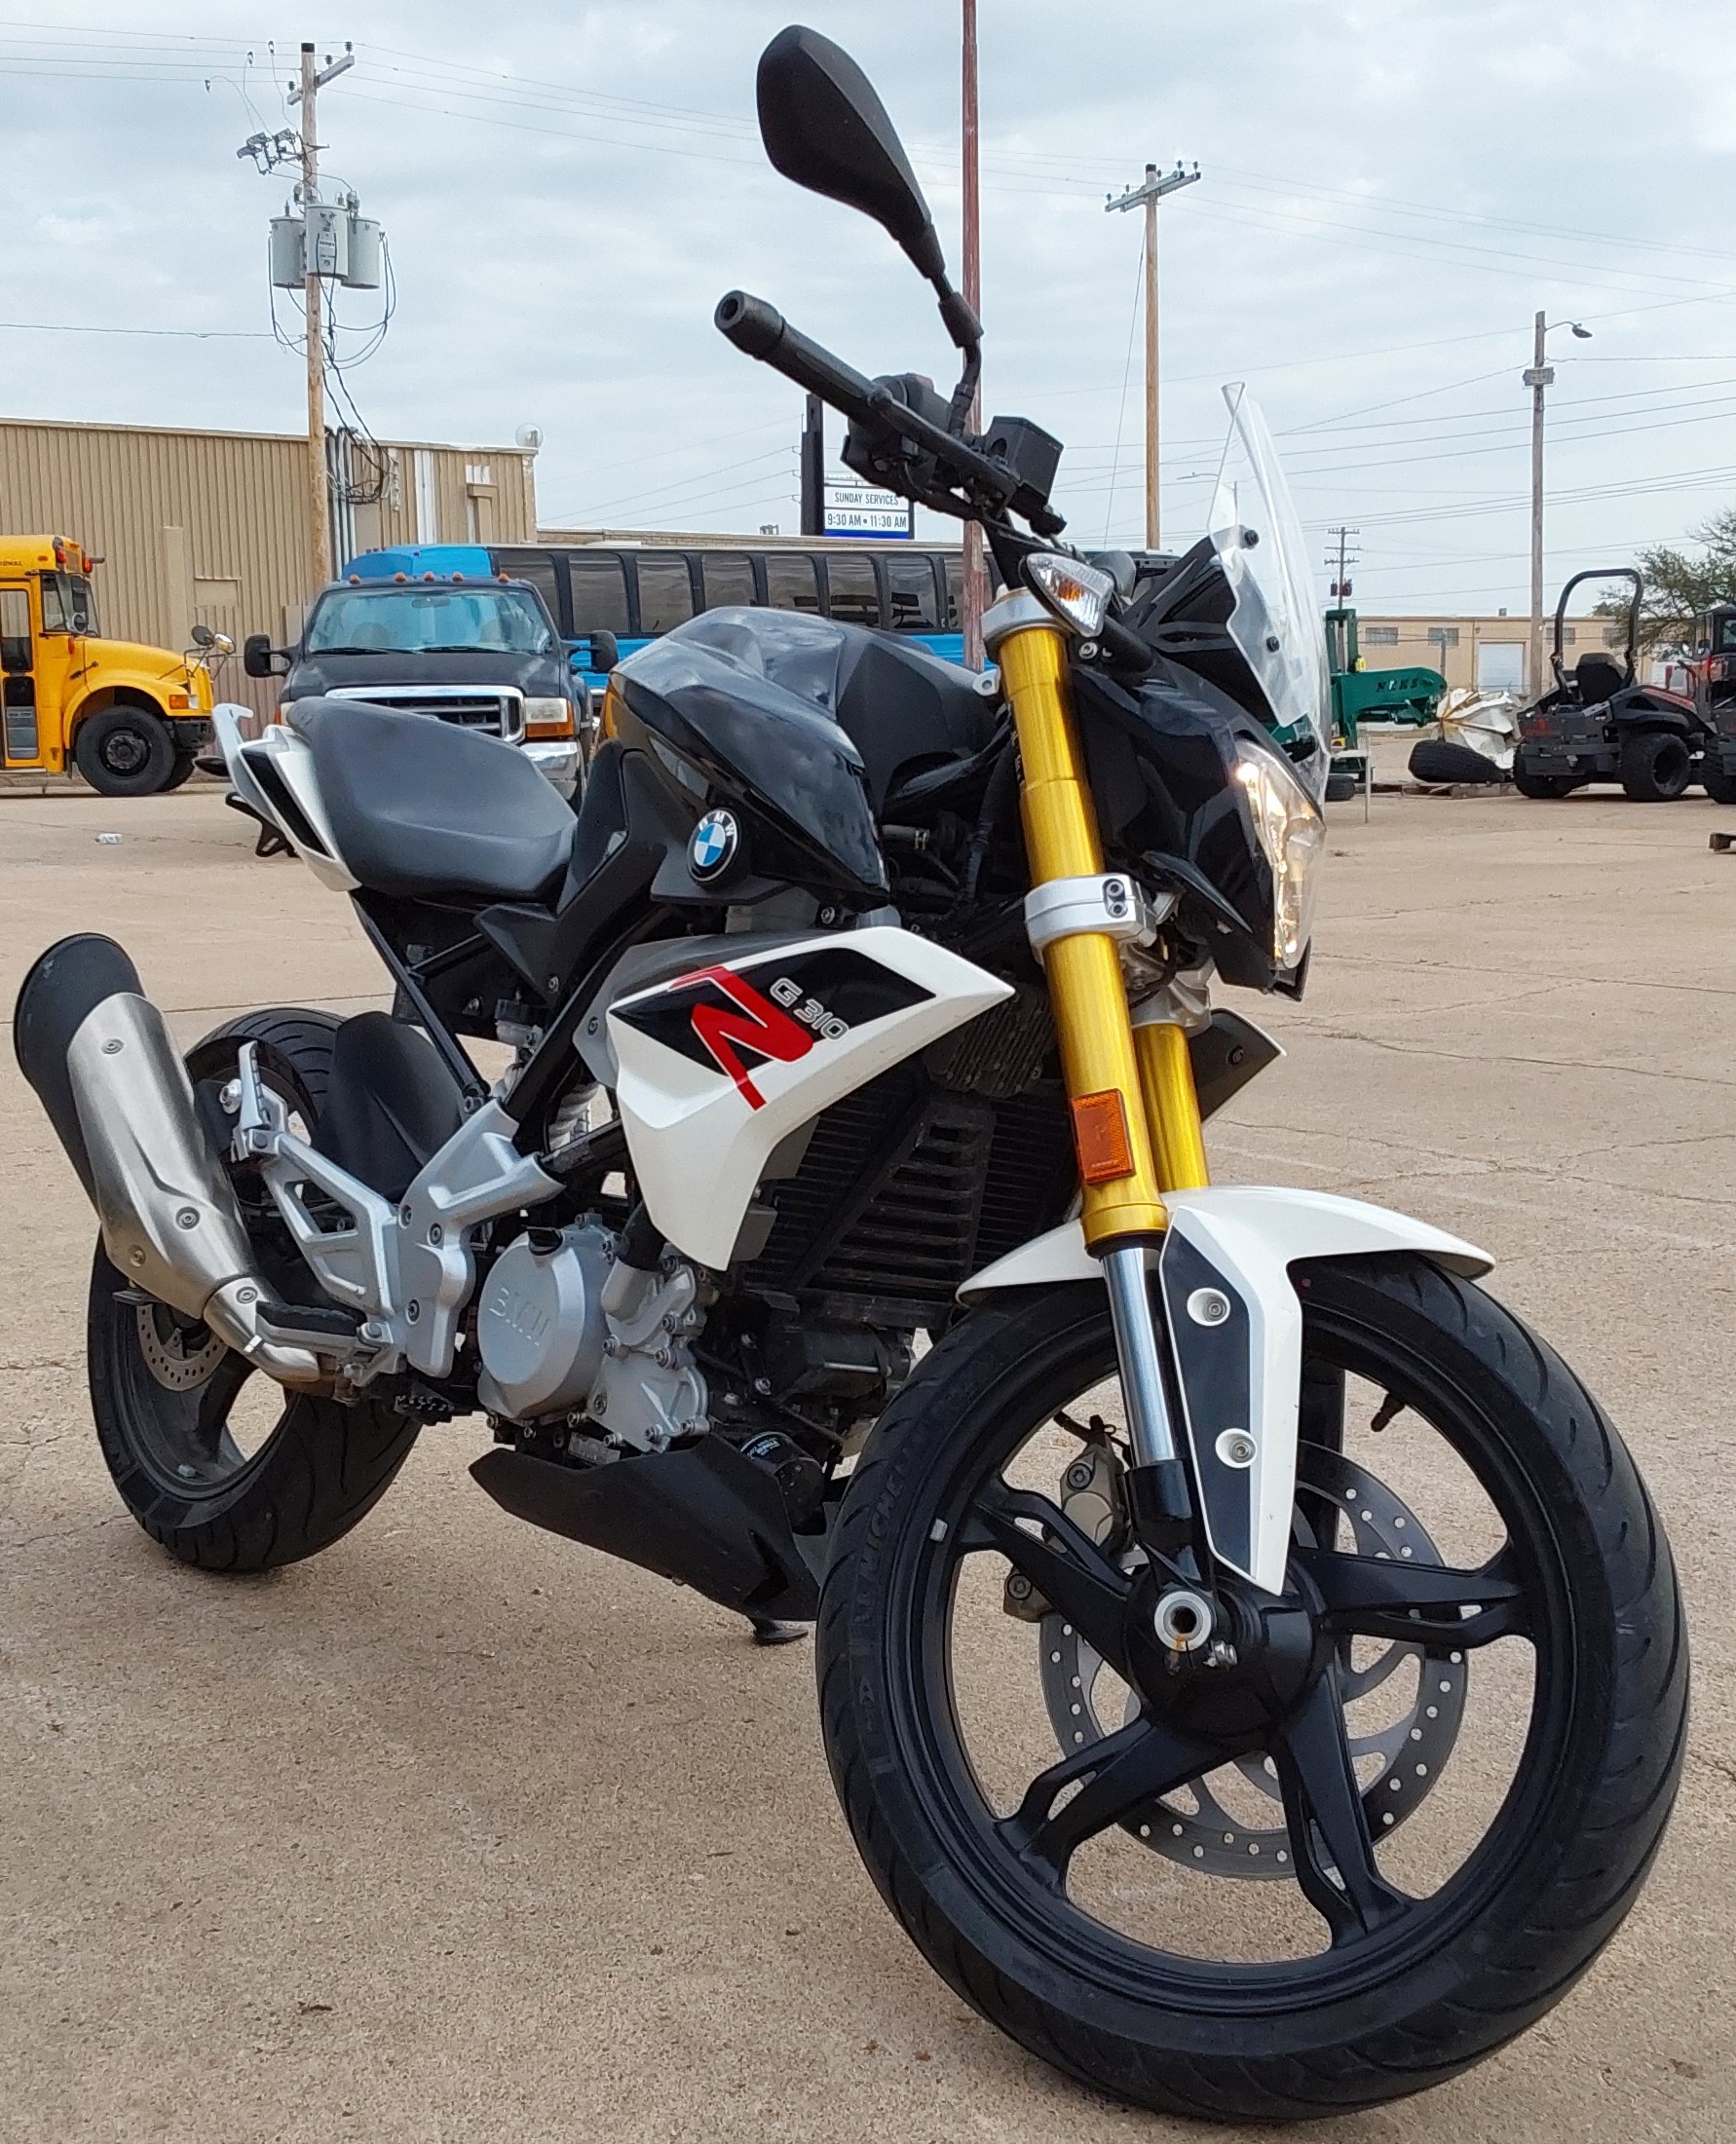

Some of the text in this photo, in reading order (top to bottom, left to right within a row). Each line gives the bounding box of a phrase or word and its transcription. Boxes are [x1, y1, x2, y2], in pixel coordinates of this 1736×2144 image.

[835, 492, 898, 506] SUNDAY SERVICES
[827, 513, 907, 528] 9:30 AM 11:30 AM
[770, 977, 849, 1040] G 310
